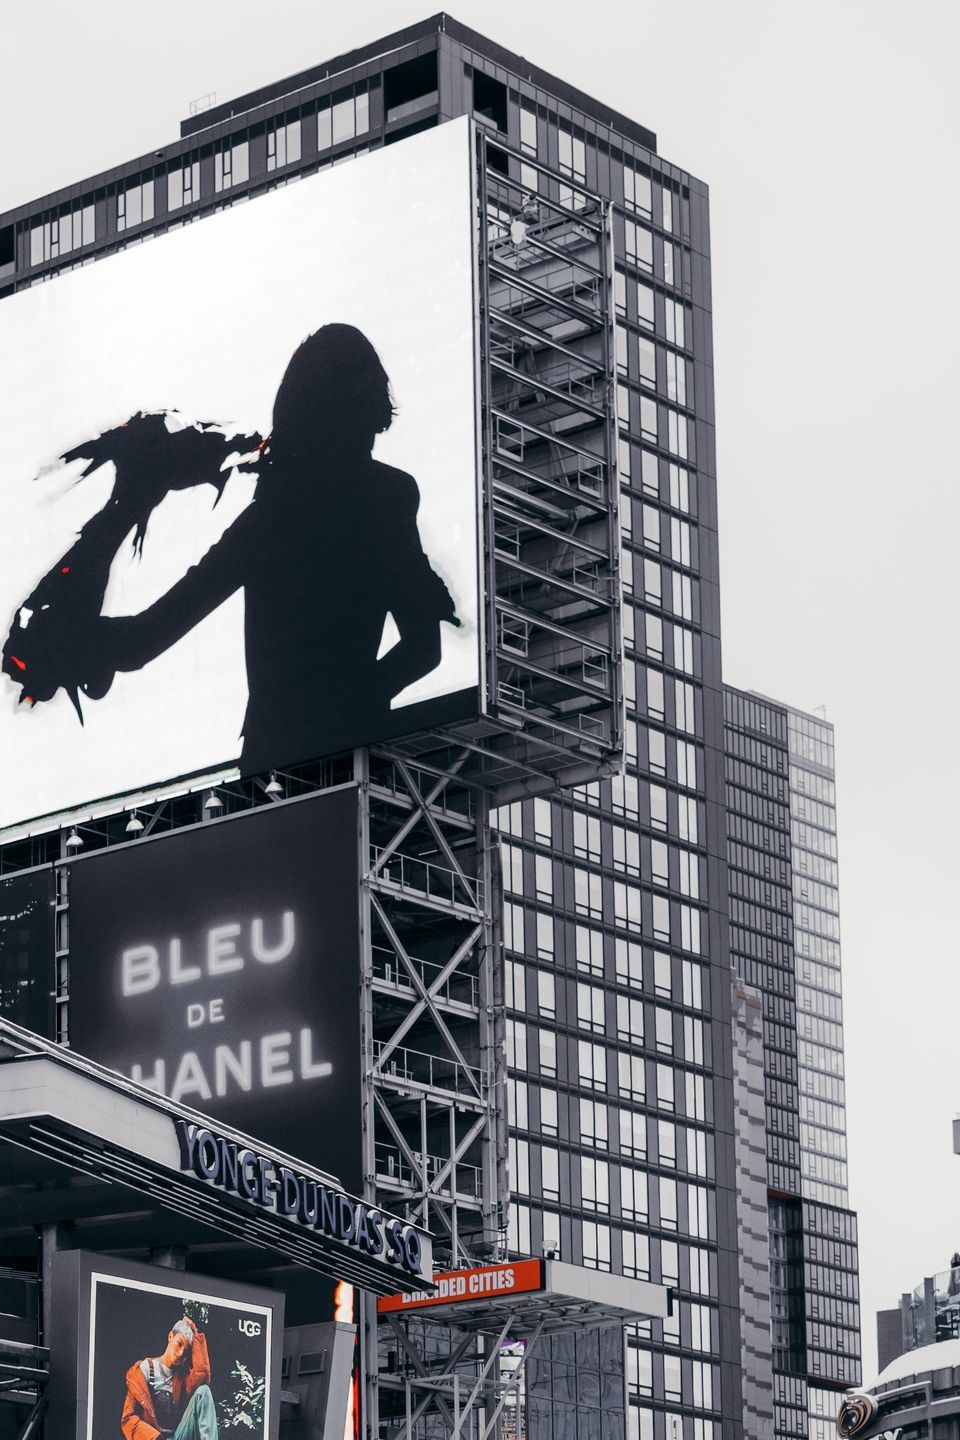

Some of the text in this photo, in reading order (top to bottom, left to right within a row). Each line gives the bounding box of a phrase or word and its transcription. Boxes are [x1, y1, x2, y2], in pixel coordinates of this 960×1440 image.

[122, 911, 295, 997] BLEU
[187, 998, 225, 1028] DE
[131, 1028, 333, 1102] HANEL
[176, 1120, 423, 1275] YONGE-DUNDAS SQ
[469, 1269, 515, 1292] CITIES
[238, 1319, 261, 1337] UGG
